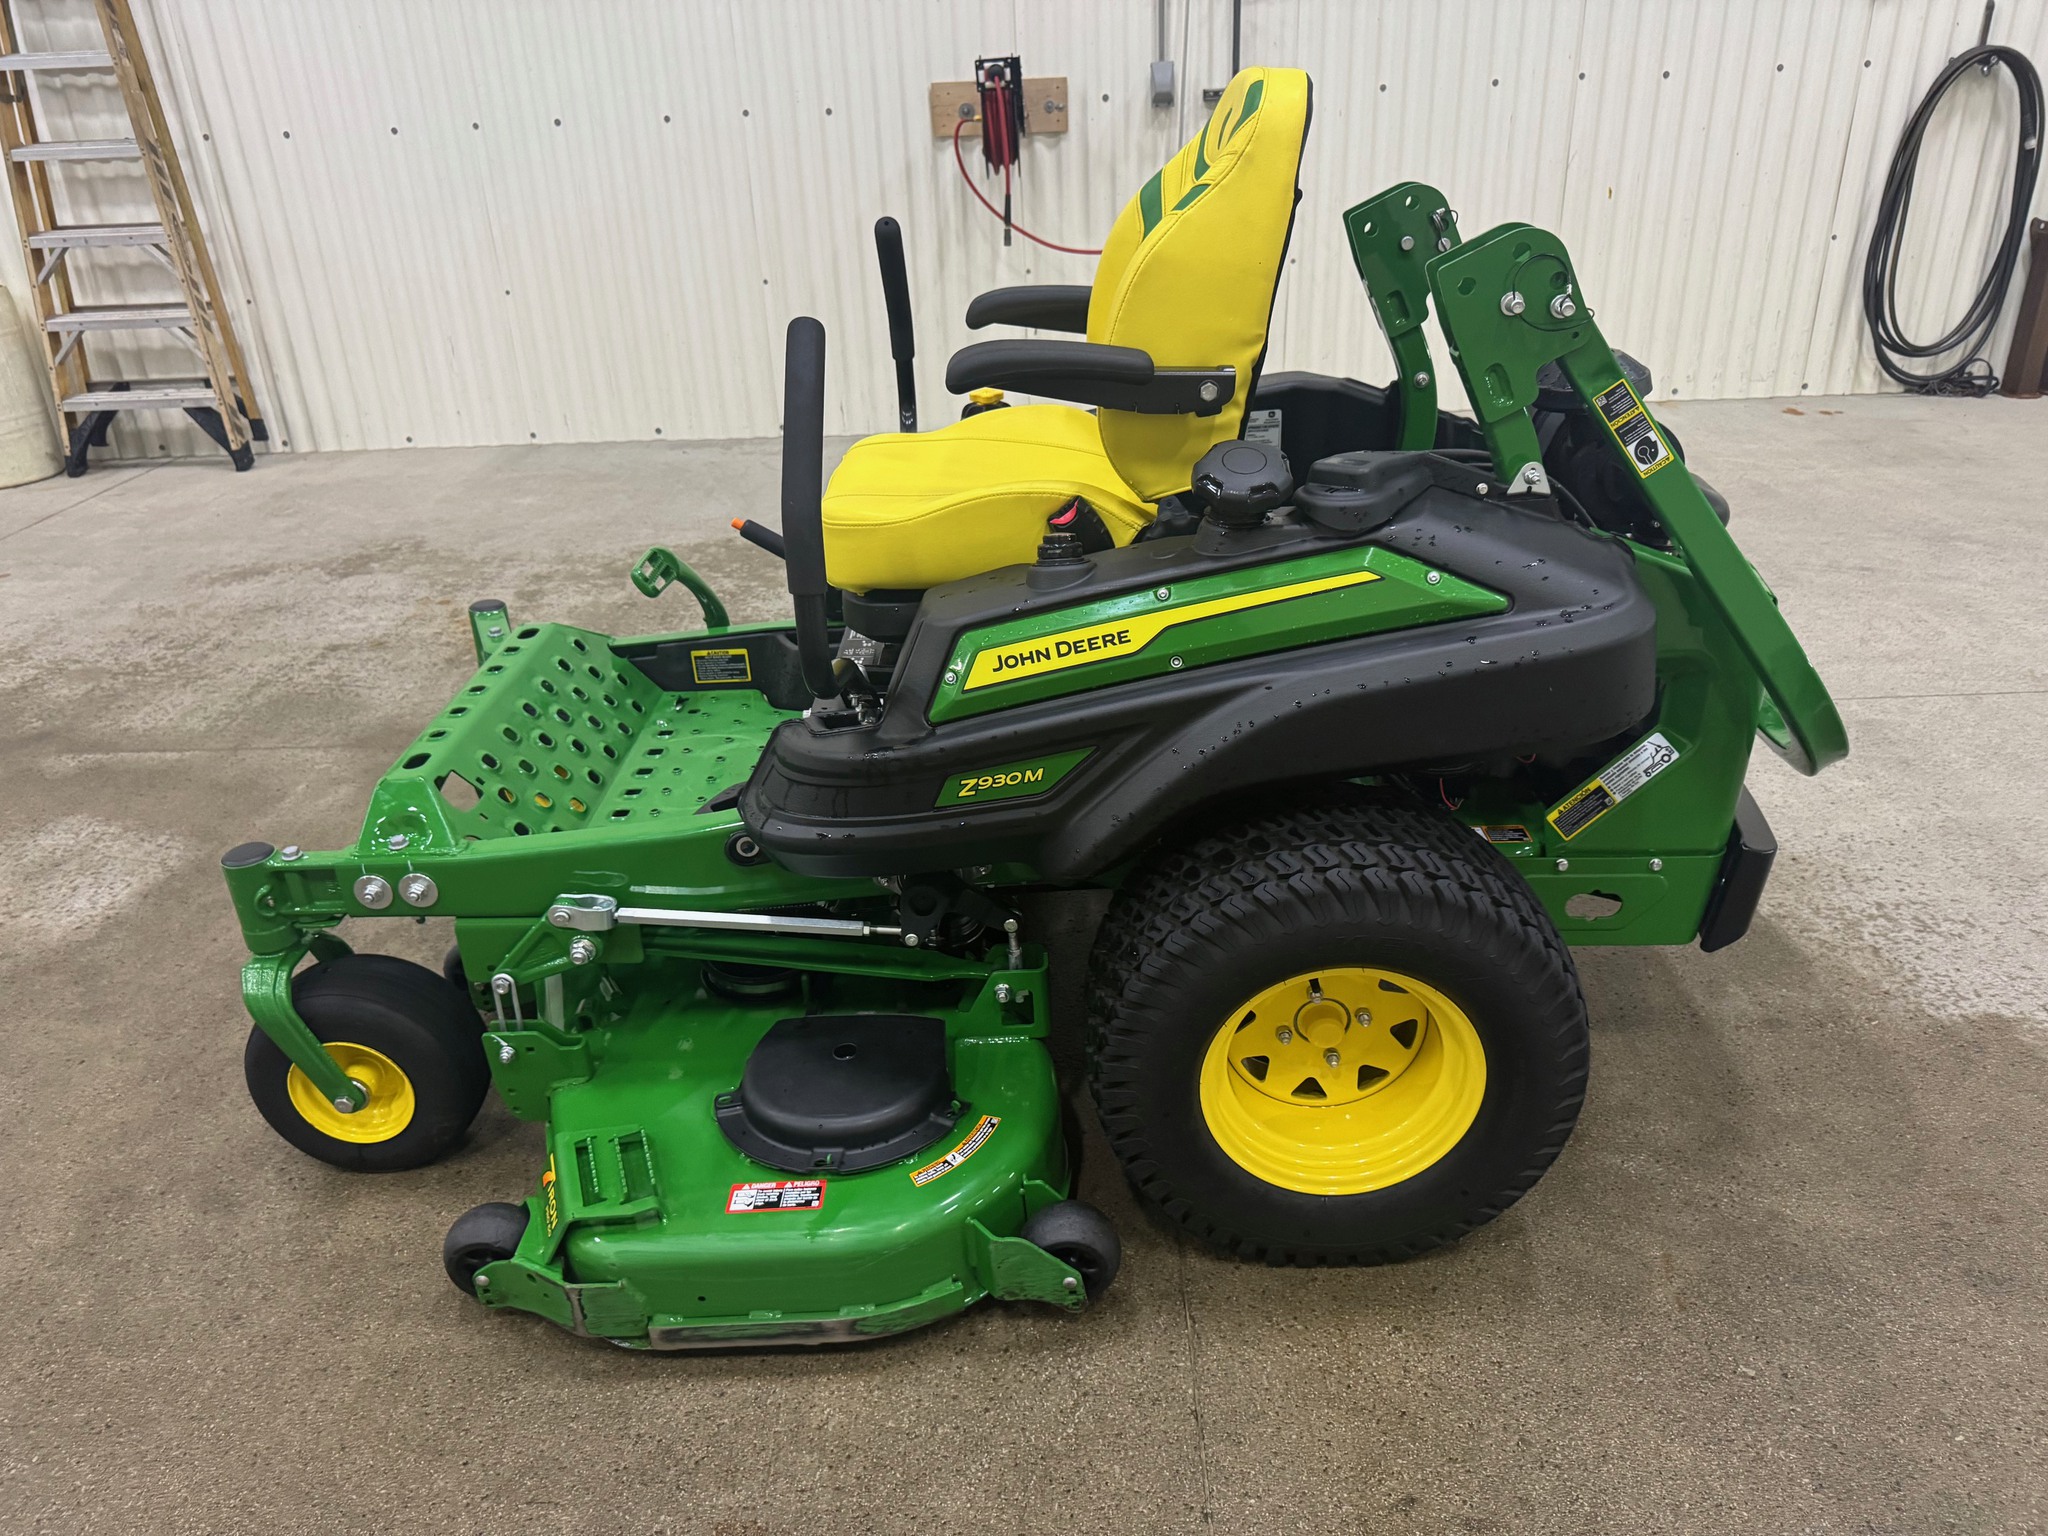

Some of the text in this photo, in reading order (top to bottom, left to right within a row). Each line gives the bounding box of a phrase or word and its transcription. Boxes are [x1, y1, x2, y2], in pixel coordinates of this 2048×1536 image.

[1643, 459, 1667, 477] CAUTION
[992, 629, 1131, 673] JOHN DEERE
[958, 767, 1044, 797] Z930M
[1562, 786, 1591, 811] ATENCIÓN
